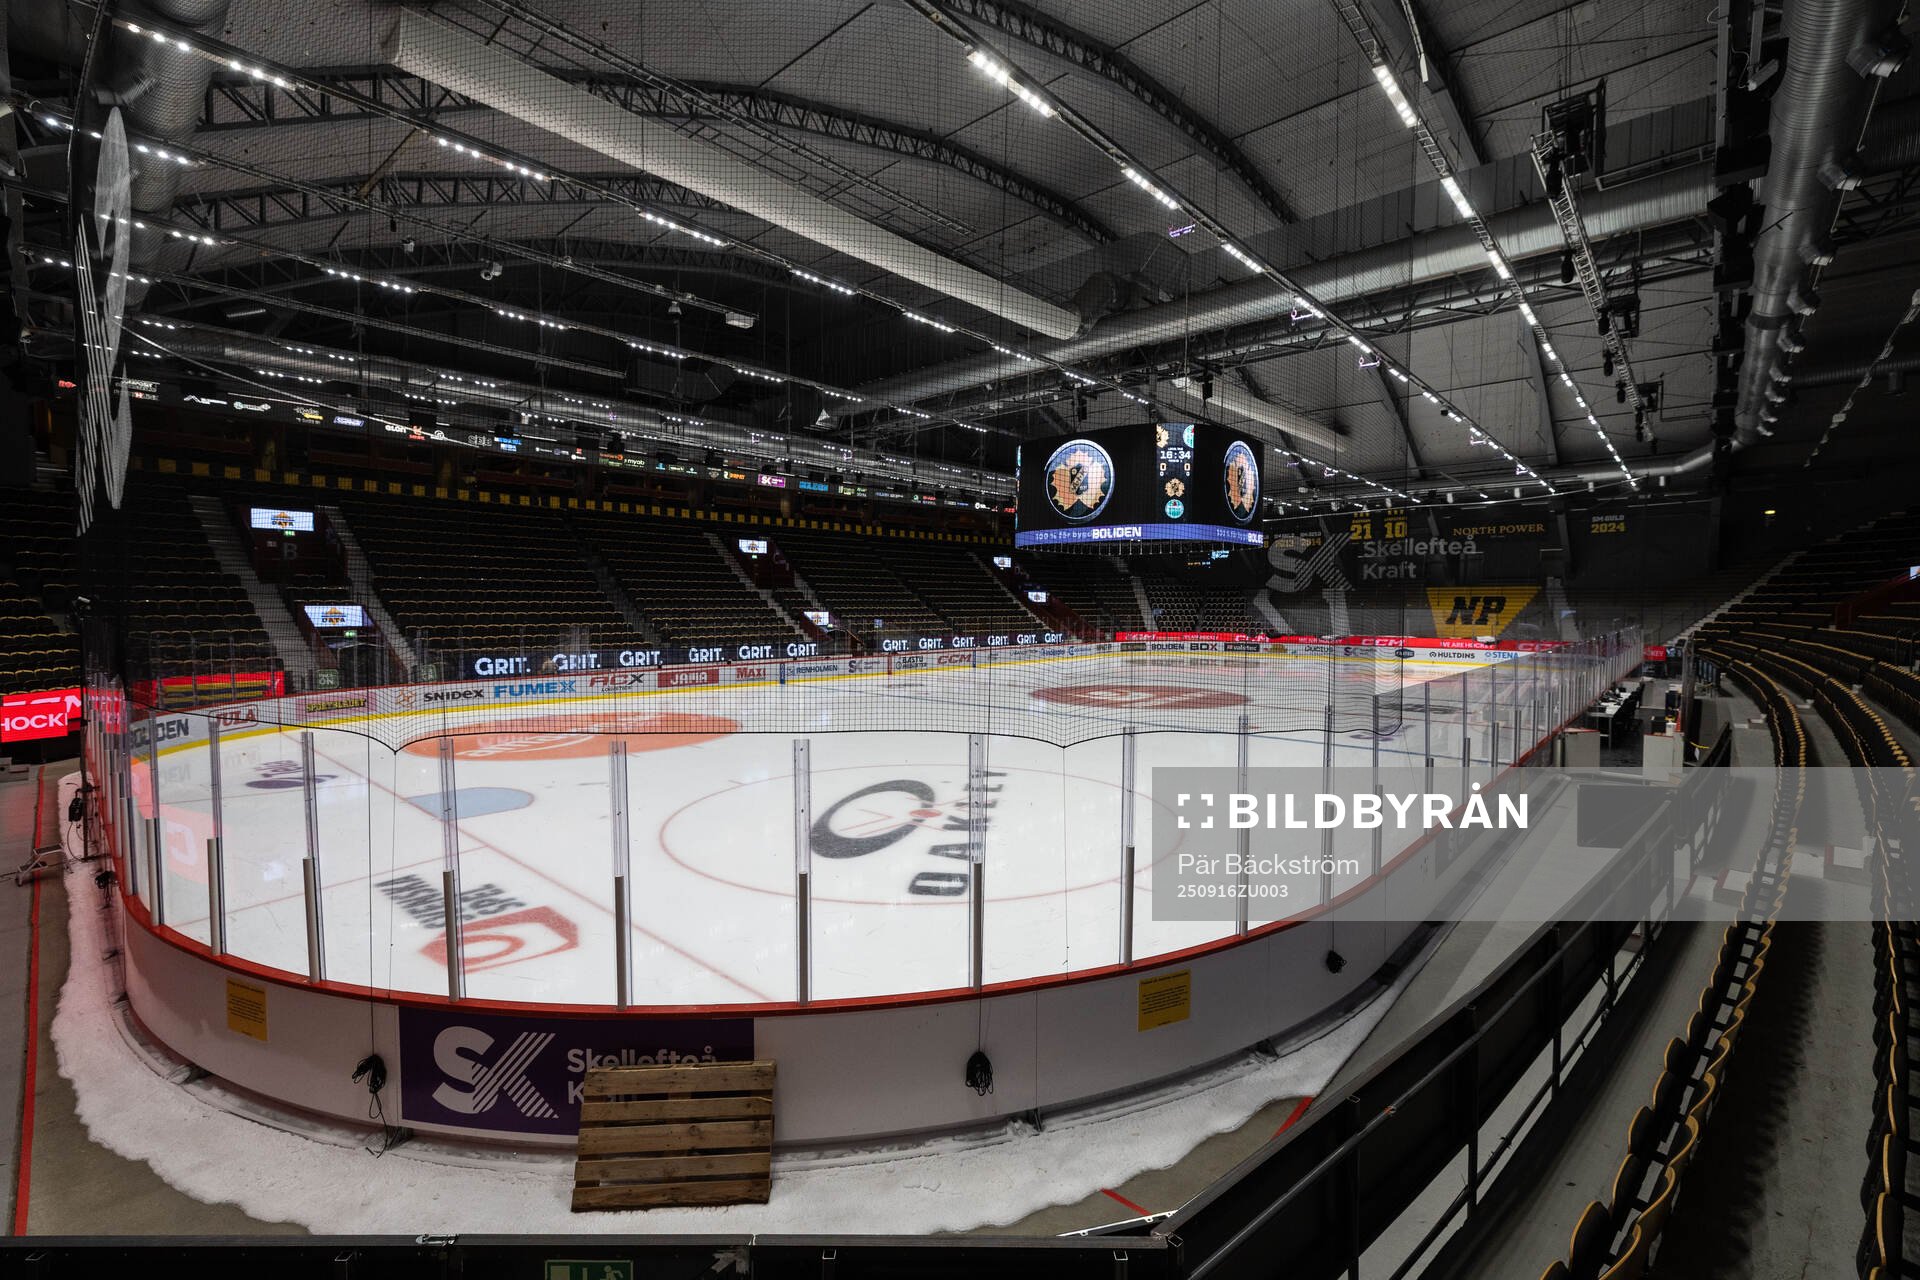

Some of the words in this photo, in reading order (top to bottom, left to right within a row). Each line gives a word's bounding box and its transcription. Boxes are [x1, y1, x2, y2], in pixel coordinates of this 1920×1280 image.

[1160, 451, 1191, 459] 16:34
[1092, 527, 1141, 539] BOLIDEN
[1350, 524, 1372, 540] 21
[1384, 522, 1407, 538] 10
[1453, 526, 1496, 536] NORTH
[1500, 523, 1545, 533] POWER
[1591, 522, 1626, 533] 2024
[1363, 535, 1477, 557] Skellefteå
[1362, 562, 1416, 580] Kraft
[1446, 596, 1507, 625] NP
[739, 645, 774, 660] GRIT.
[786, 643, 819, 657] GRIT.
[1190, 643, 1218, 651] BDX
[620, 651, 664, 667] GRIT.
[689, 648, 725, 663] GRIT.
[937, 654, 971, 665] CCM
[475, 657, 531, 676] GRIT.
[494, 680, 577, 699] FUMEX
